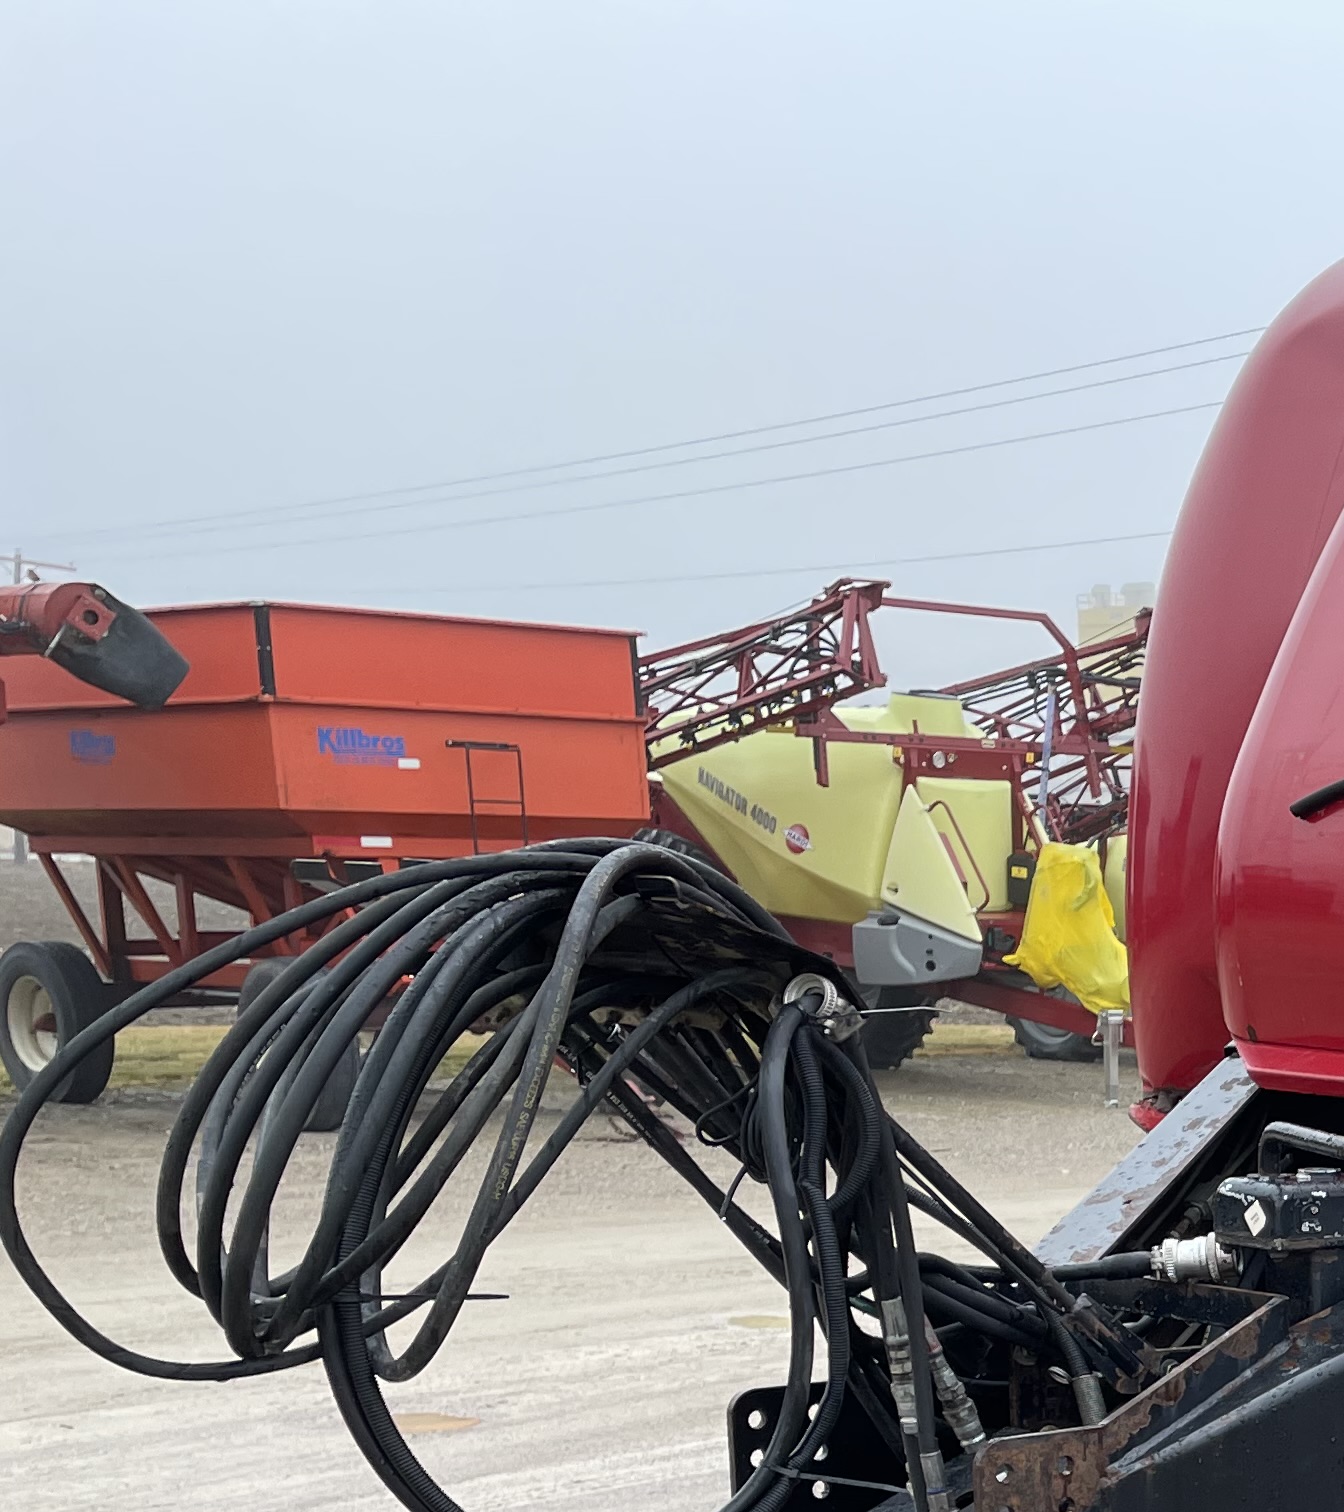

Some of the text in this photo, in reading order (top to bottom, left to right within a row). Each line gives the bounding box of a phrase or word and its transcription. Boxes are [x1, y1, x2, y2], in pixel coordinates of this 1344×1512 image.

[317, 726, 405, 758] Killbros
[697, 766, 778, 835] NAVIGATOR 4000
